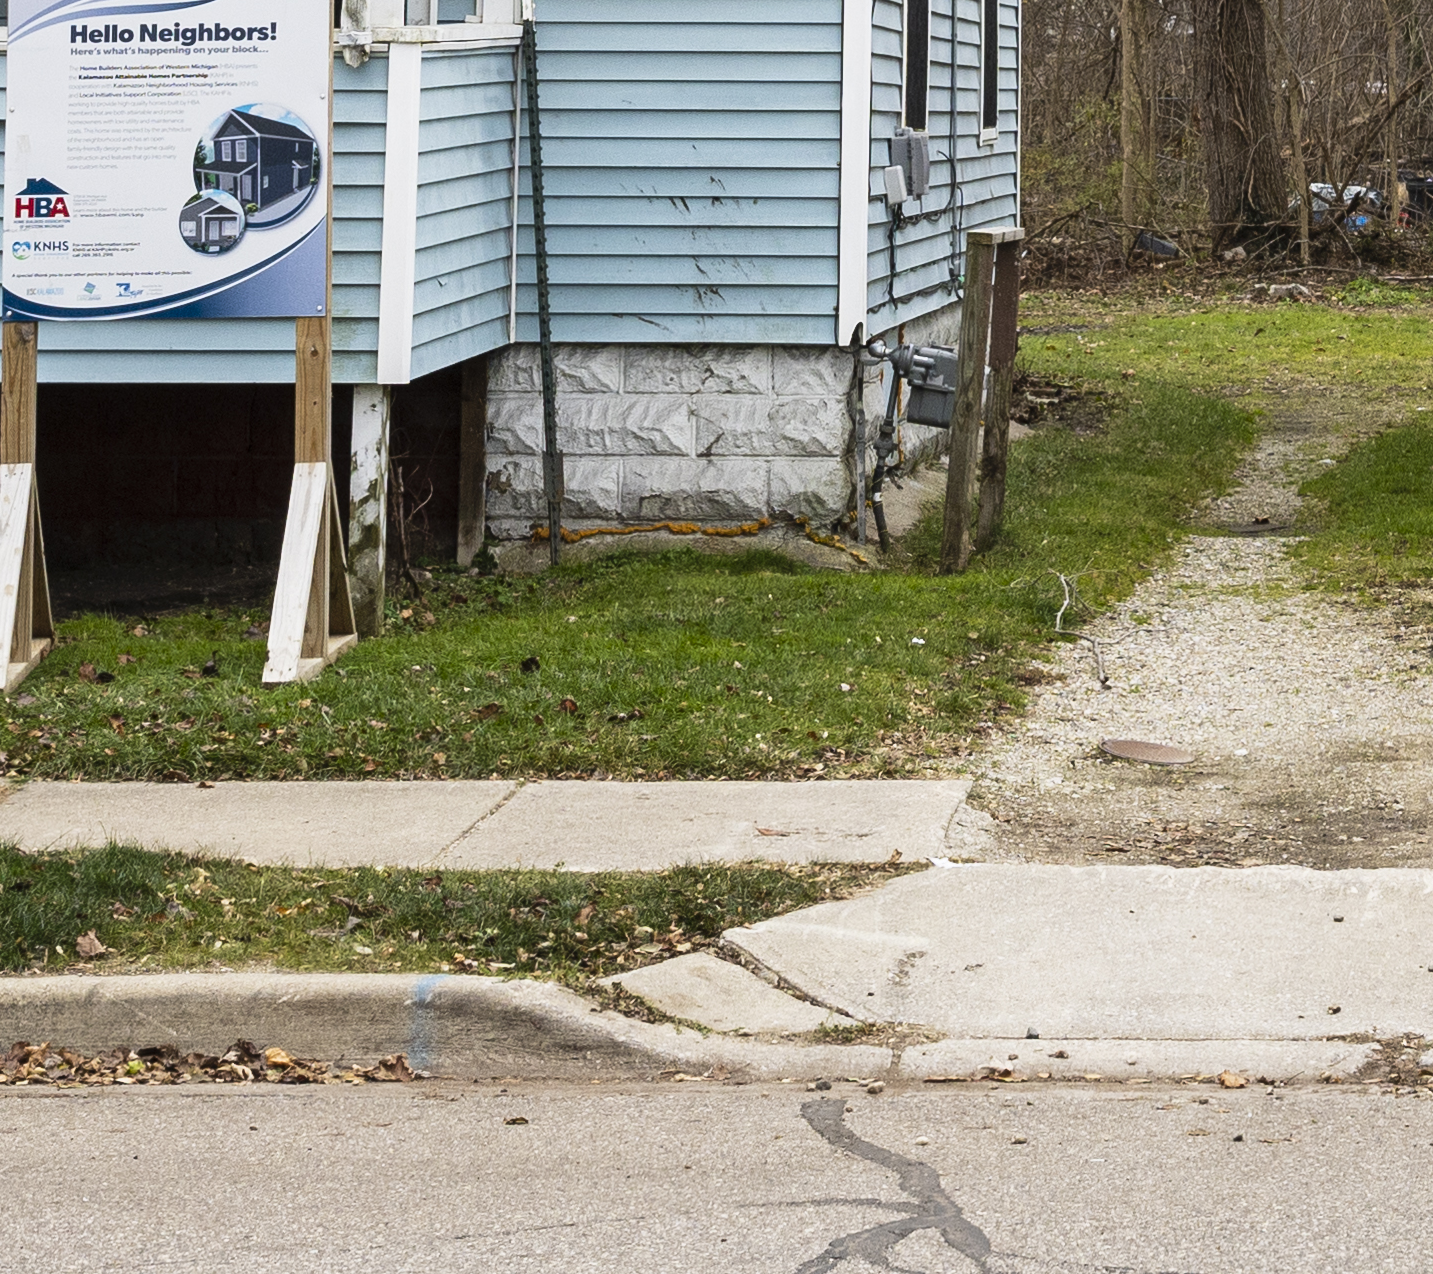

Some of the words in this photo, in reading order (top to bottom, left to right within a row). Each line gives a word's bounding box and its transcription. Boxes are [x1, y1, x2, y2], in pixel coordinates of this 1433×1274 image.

[70, 24, 134, 43] Hello
[139, 22, 277, 46] Neighbors!
[70, 47, 101, 55] Here's
[103, 47, 135, 55] what's
[138, 46, 191, 56] happening
[232, 45, 269, 53] block...
[15, 197, 70, 218] HBA
[34, 241, 69, 251] KNHS
